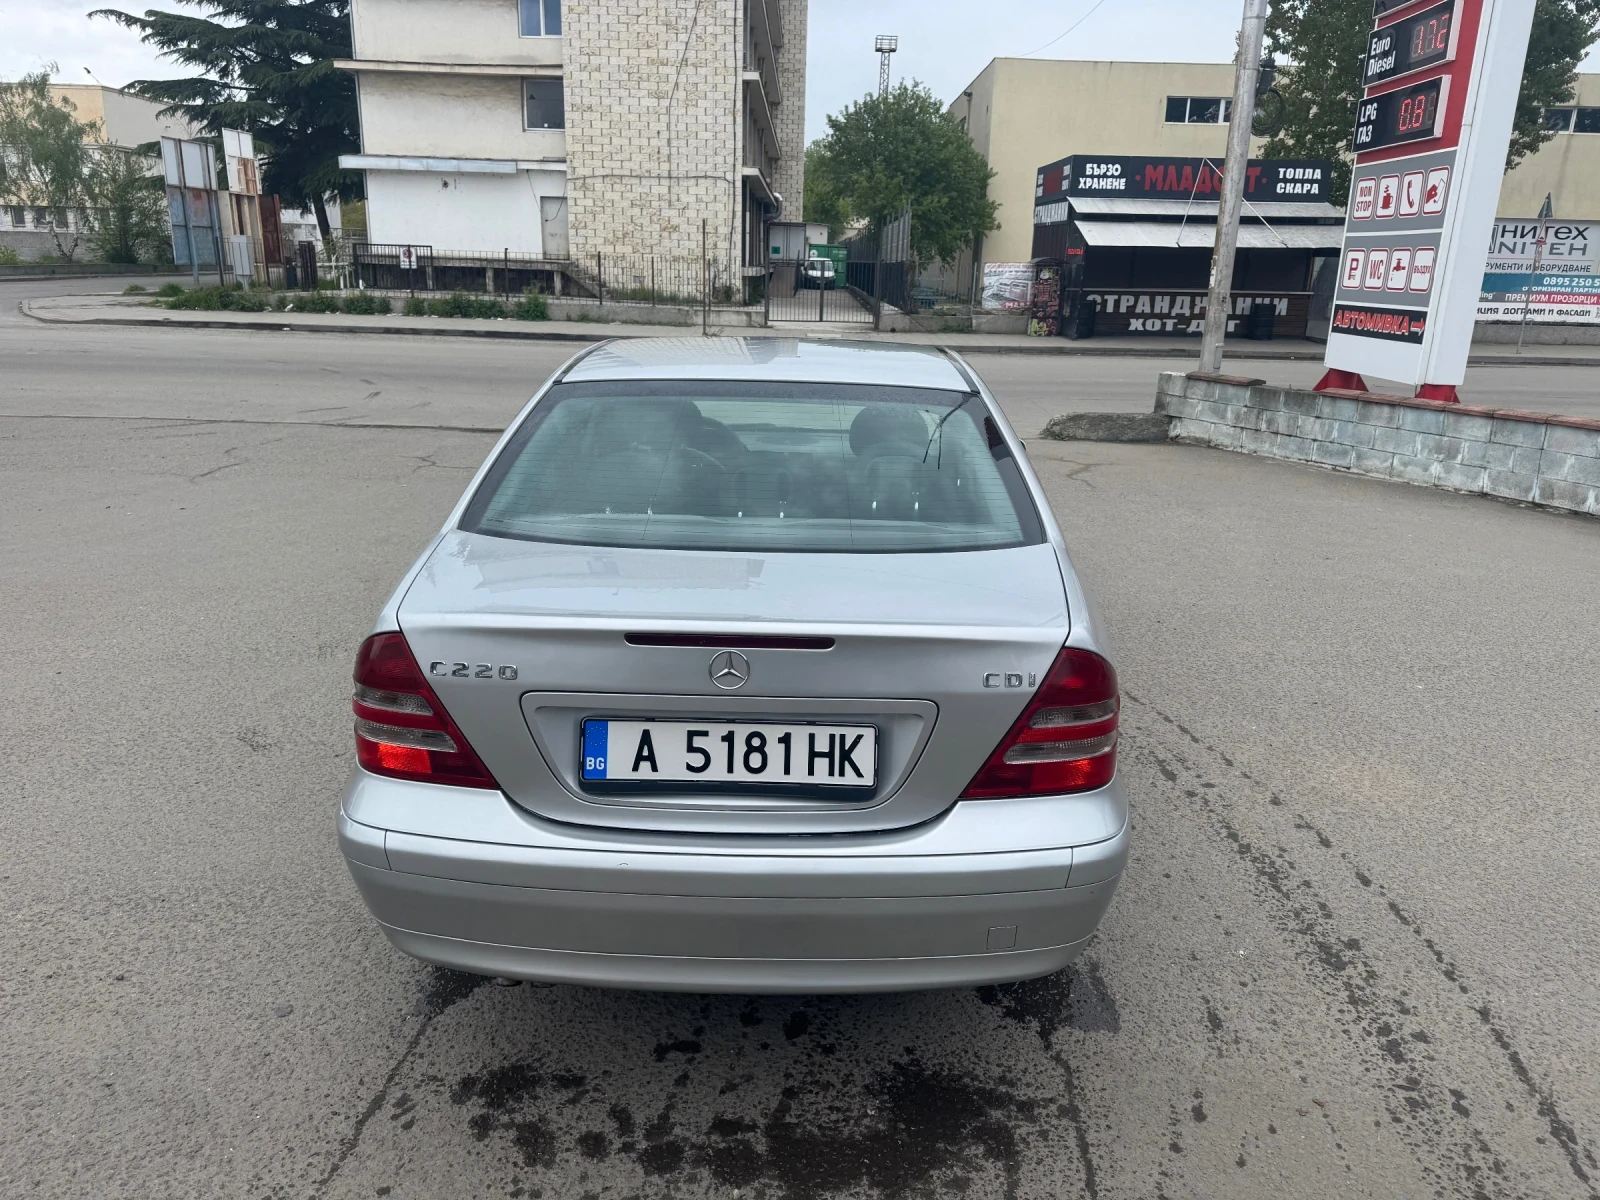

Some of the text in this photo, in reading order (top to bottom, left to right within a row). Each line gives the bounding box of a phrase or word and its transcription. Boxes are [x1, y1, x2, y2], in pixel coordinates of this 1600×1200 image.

[1371, 37, 1391, 56] Euro
[1368, 50, 1396, 76] Diesel
[1360, 102, 1378, 123] LPG
[1356, 124, 1373, 144] ГАЗ
[1085, 163, 1122, 176] БЪРЗО
[1278, 168, 1322, 180] ТОПЛА
[1078, 177, 1127, 190] ХРАНЕНЕ
[1144, 164, 1262, 193] МЛАДОТ
[1276, 182, 1319, 195] СКАРА
[1359, 185, 1373, 197] NON
[1355, 200, 1372, 212] STOP
[1369, 260, 1384, 280] WC
[1535, 263, 1592, 274] БОРУДВАНЕ
[1543, 276, 1571, 286] 0895
[1571, 278, 1592, 288] 250
[1550, 294, 1598, 305] ПРОЗОРЦИ
[1556, 308, 1591, 317] ФАСАДИ
[1128, 318, 1240, 333] ХОТ-ДГ
[1333, 309, 1409, 335] АВТОМИВКА
[982, 672, 1036, 688] CDI
[586, 757, 605, 770] BG
